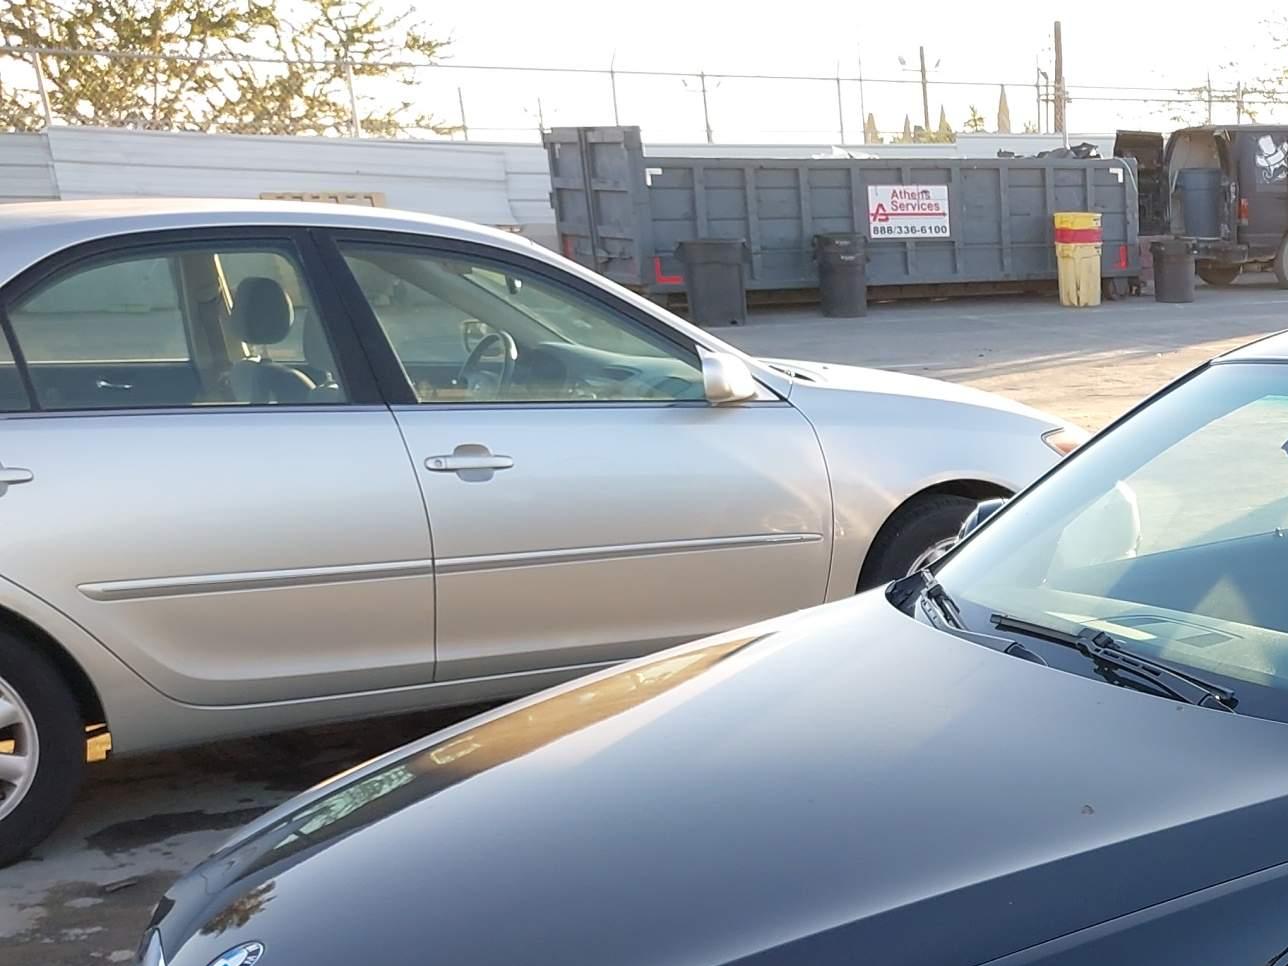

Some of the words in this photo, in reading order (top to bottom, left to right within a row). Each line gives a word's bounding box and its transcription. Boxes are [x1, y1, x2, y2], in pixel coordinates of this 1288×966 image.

[891, 189, 931, 200] Athens
[891, 200, 940, 211] Services
[873, 225, 947, 235] 888/336-6100
